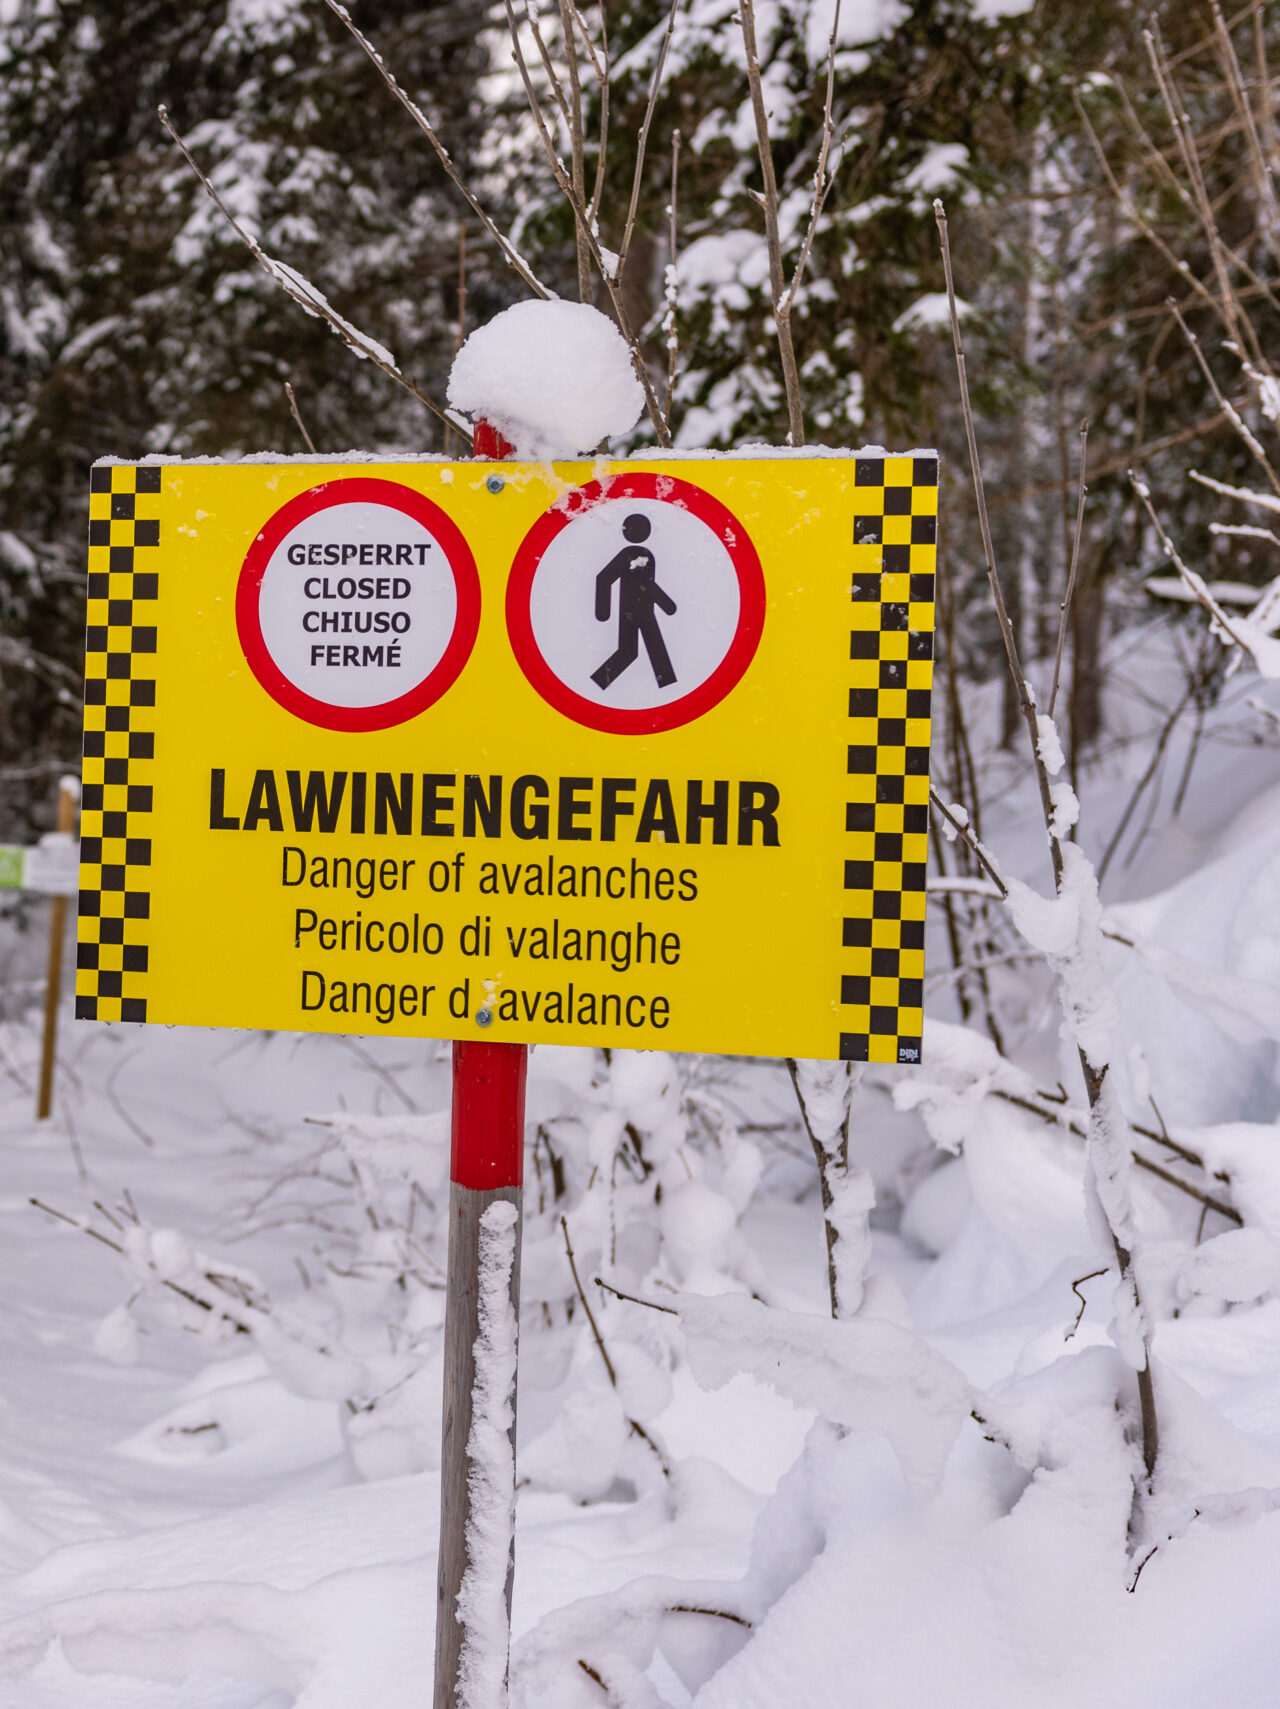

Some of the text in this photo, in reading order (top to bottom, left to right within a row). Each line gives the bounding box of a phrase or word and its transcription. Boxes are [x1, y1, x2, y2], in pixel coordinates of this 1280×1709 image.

[287, 543, 432, 566] GESPERRT
[303, 577, 412, 600] CLOSED
[302, 611, 411, 634] CHIUSO
[310, 638, 402, 667] FERMÉ
[209, 768, 781, 847] LAWINENGEFAHR
[282, 846, 698, 902] Danger of avalanches
[295, 908, 681, 973] Pericolo di valanghe
[301, 970, 436, 1024] Danger
